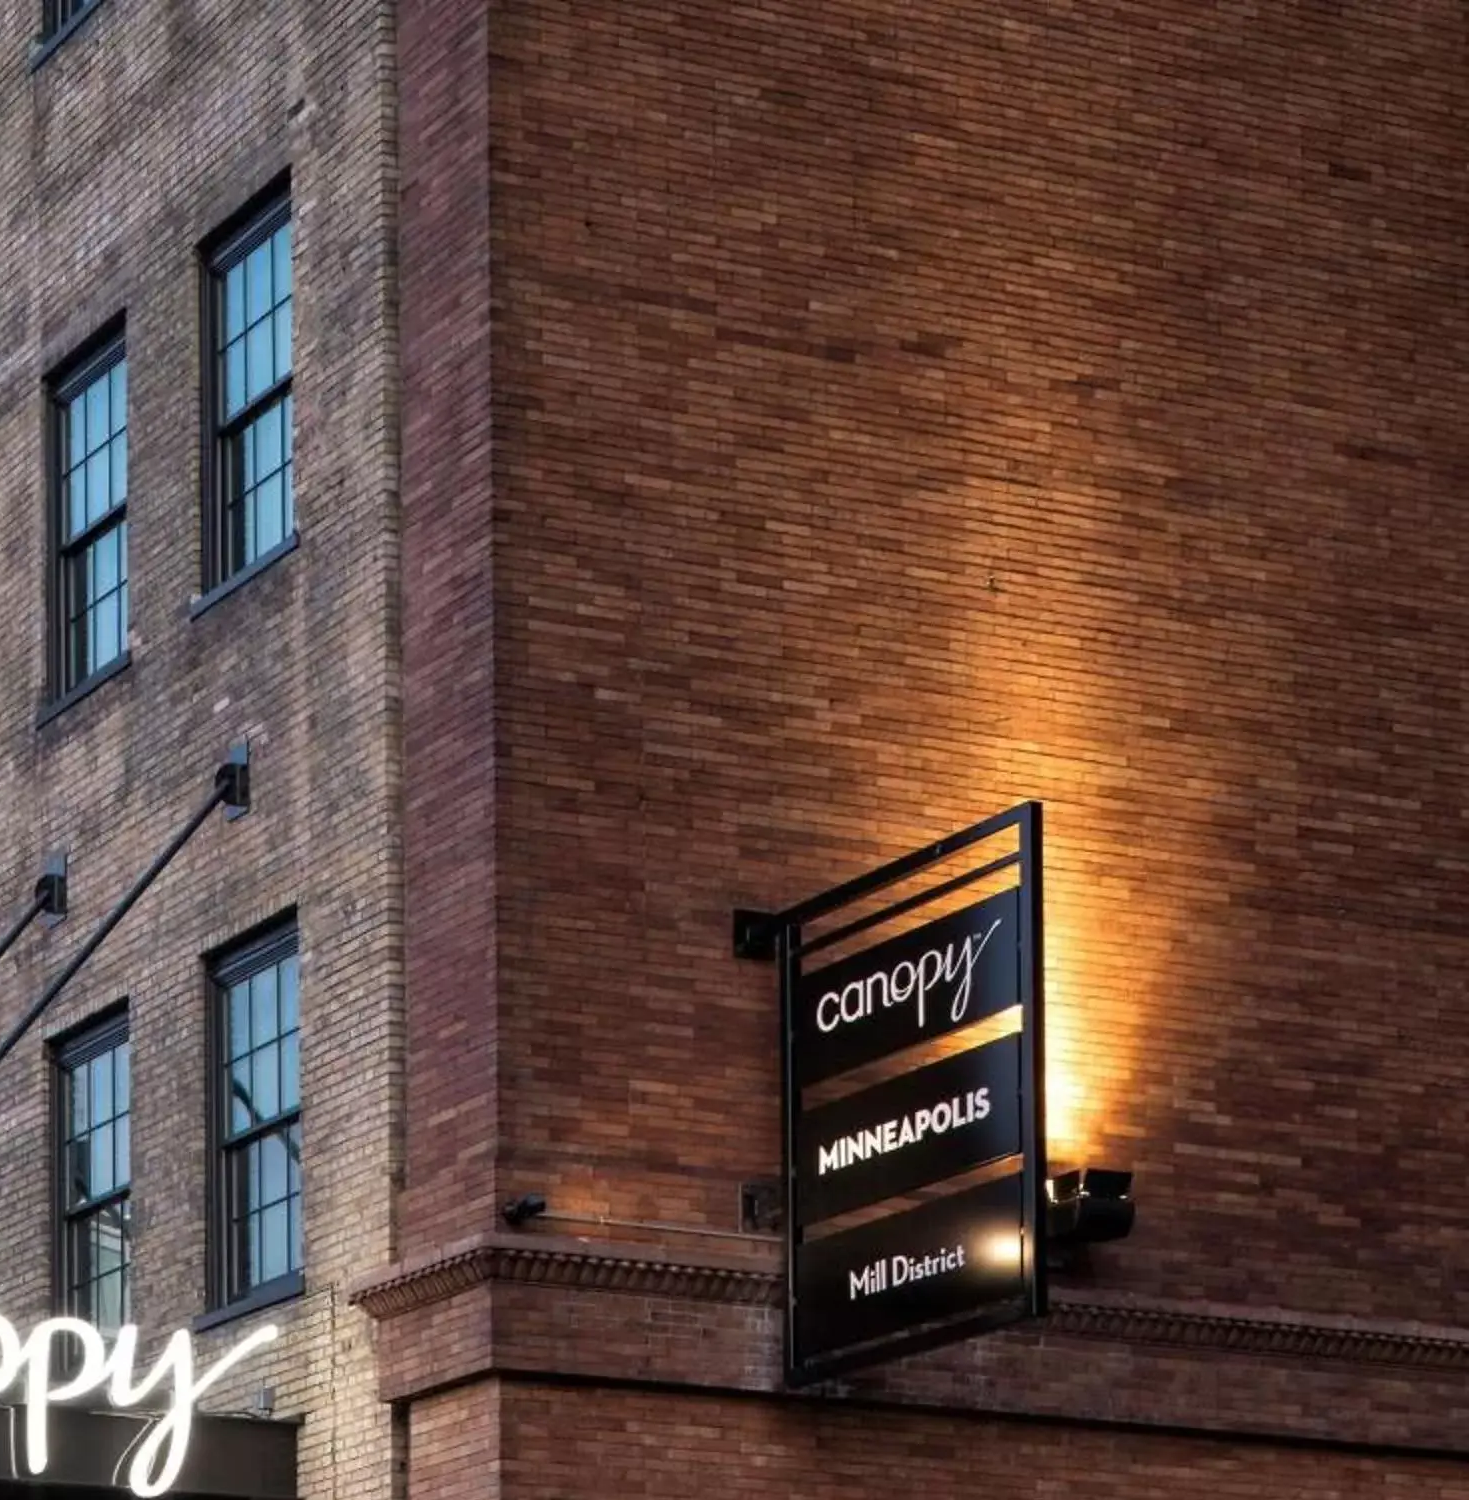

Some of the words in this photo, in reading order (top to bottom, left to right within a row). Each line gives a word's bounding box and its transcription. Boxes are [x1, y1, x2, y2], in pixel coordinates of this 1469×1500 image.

[816, 918, 1002, 1033] canopy
[818, 1087, 991, 1176] MINNEAPOLIS
[849, 1259, 887, 1300] Mill
[892, 1245, 965, 1287] District
